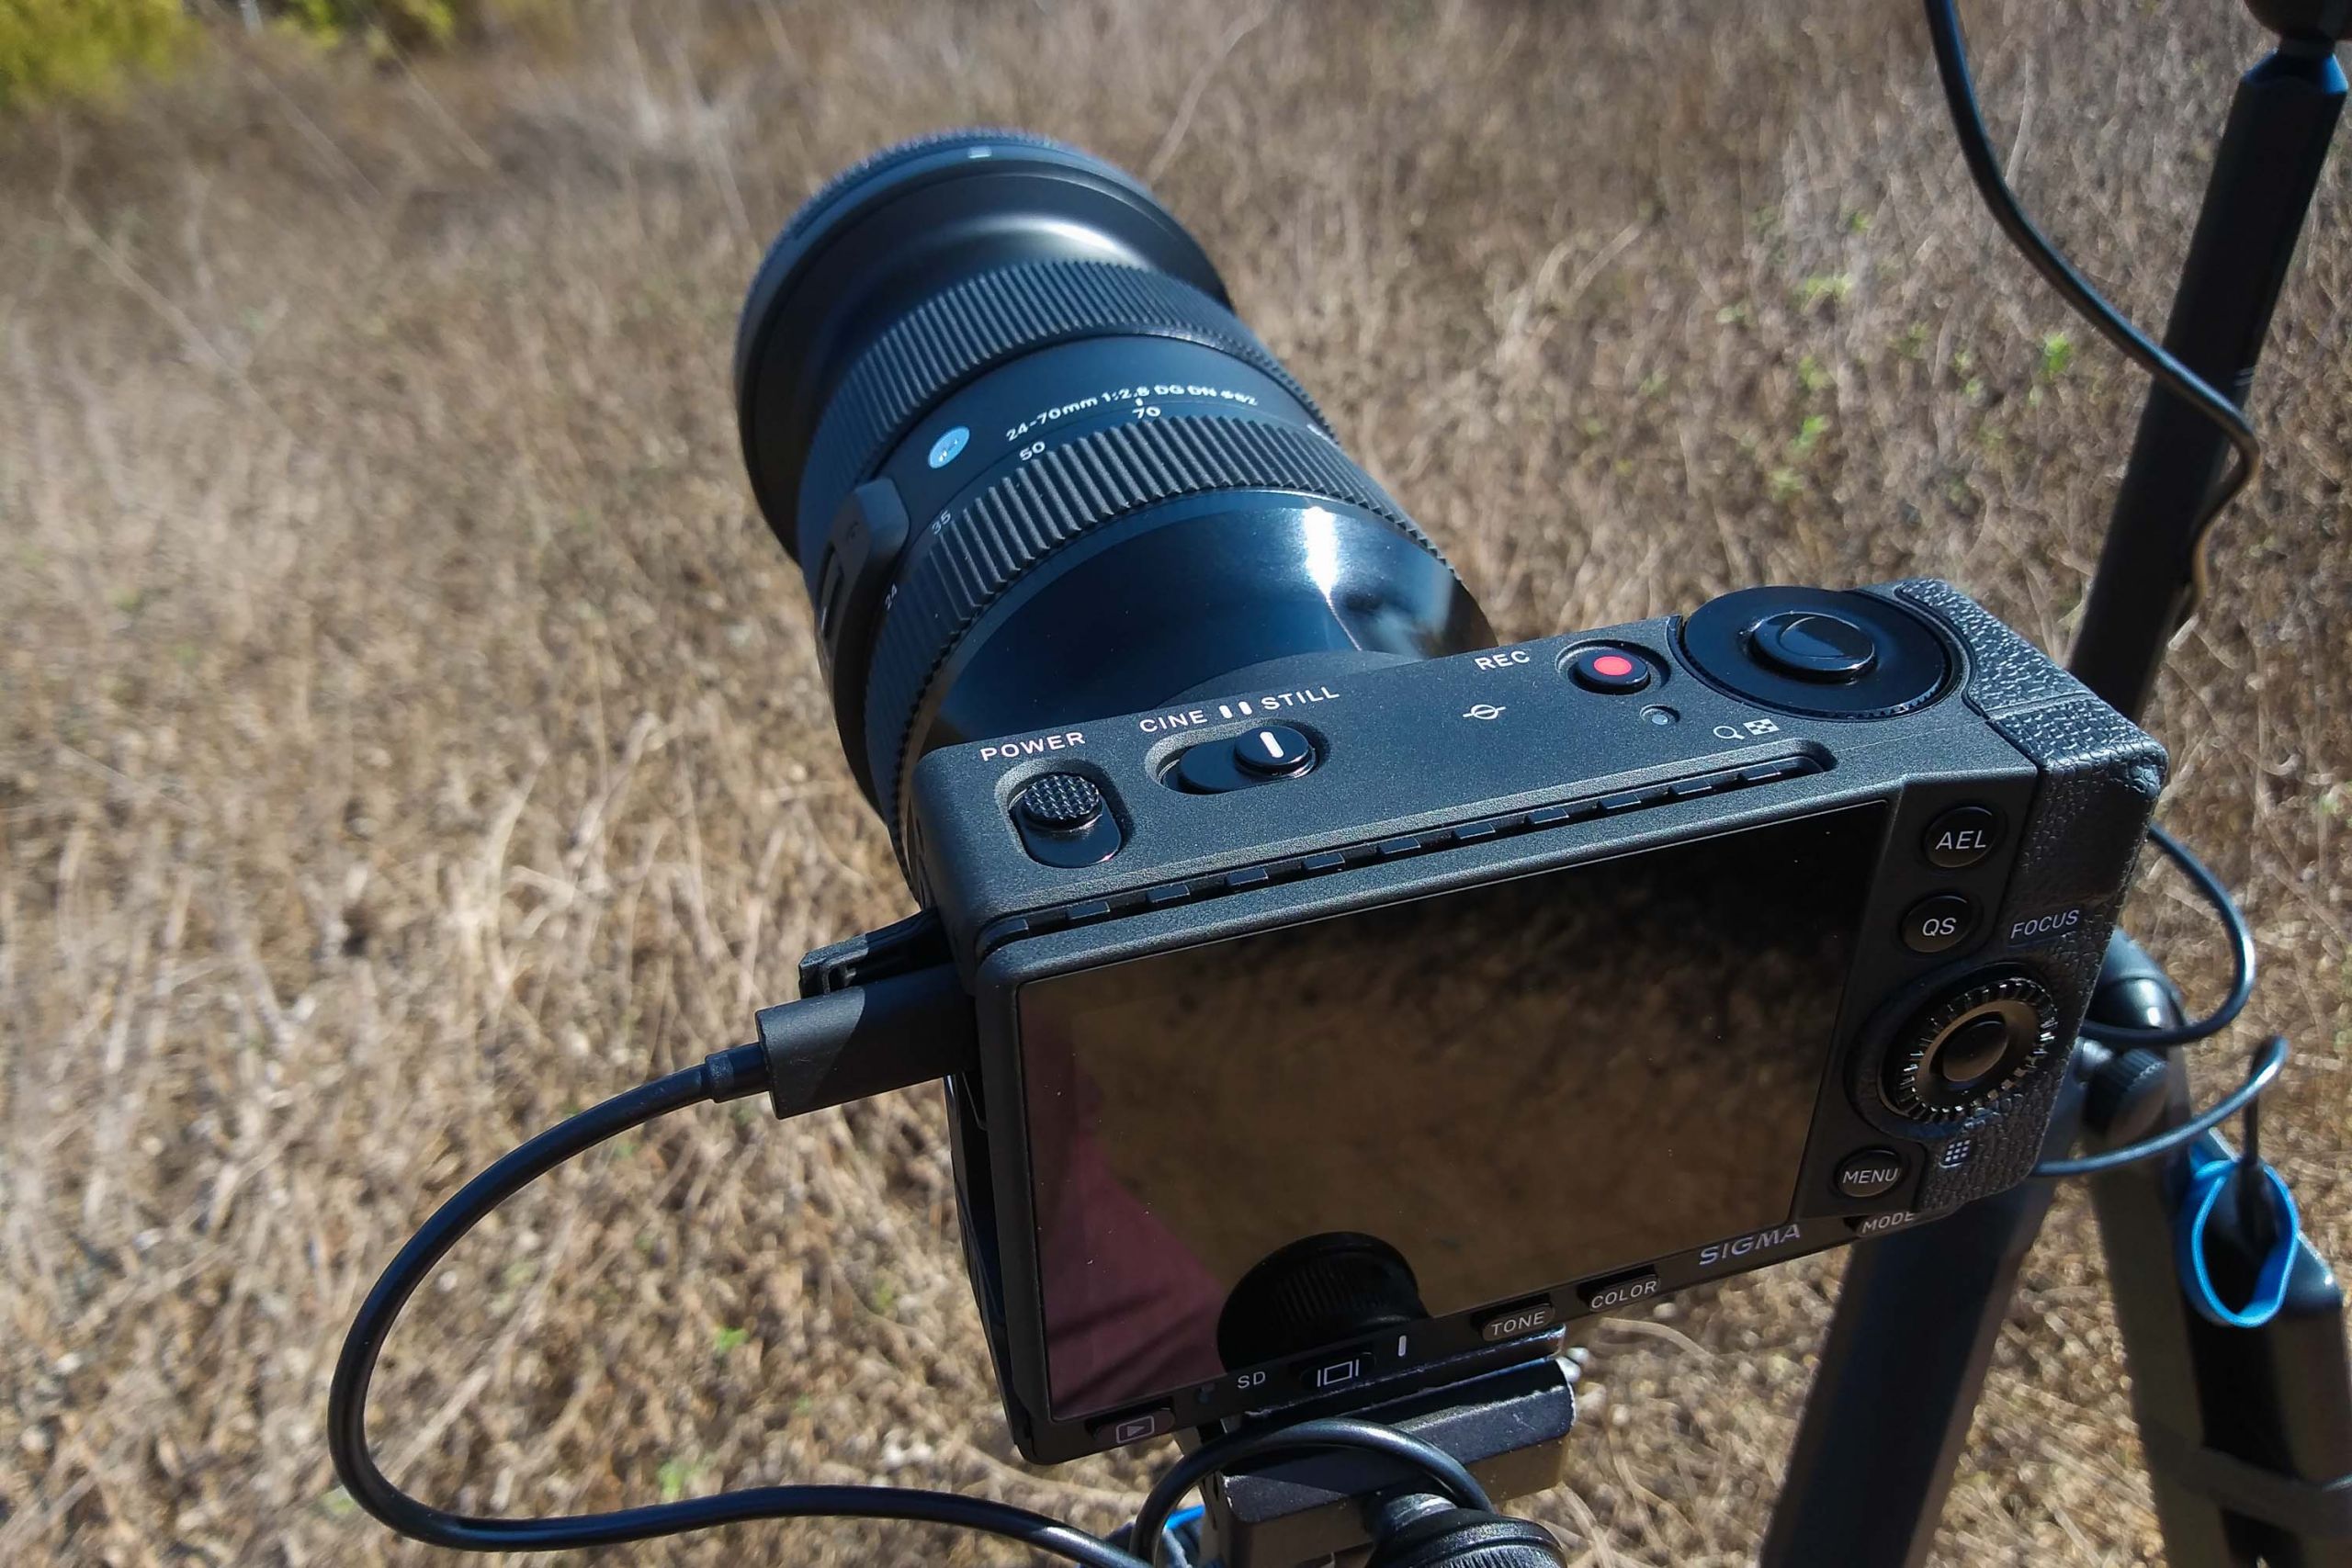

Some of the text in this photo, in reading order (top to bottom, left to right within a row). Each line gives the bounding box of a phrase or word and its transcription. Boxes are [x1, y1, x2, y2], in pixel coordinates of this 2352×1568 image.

[1006, 397, 1098, 441] 24-70mm
[1154, 384, 1185, 395] DG
[1132, 406, 1161, 419] 70
[1019, 441, 1046, 461] 50
[932, 510, 952, 536] 35
[1475, 650, 1530, 671] REC
[1261, 686, 1340, 711] STILL
[1139, 709, 1208, 734] CINE
[979, 731, 1086, 761] POWER
[1935, 829, 1987, 851] AEL
[1922, 918, 1957, 937] QS
[2010, 909, 2080, 940] FOCUS
[1842, 1168, 1899, 1185] MENU
[1861, 1211, 1914, 1234] MODE
[1698, 1224, 1801, 1266] SIGMA
[1590, 1280, 1658, 1310] COLOR
[1490, 1311, 1545, 1337] TONE
[1237, 1371, 1266, 1390] SD
